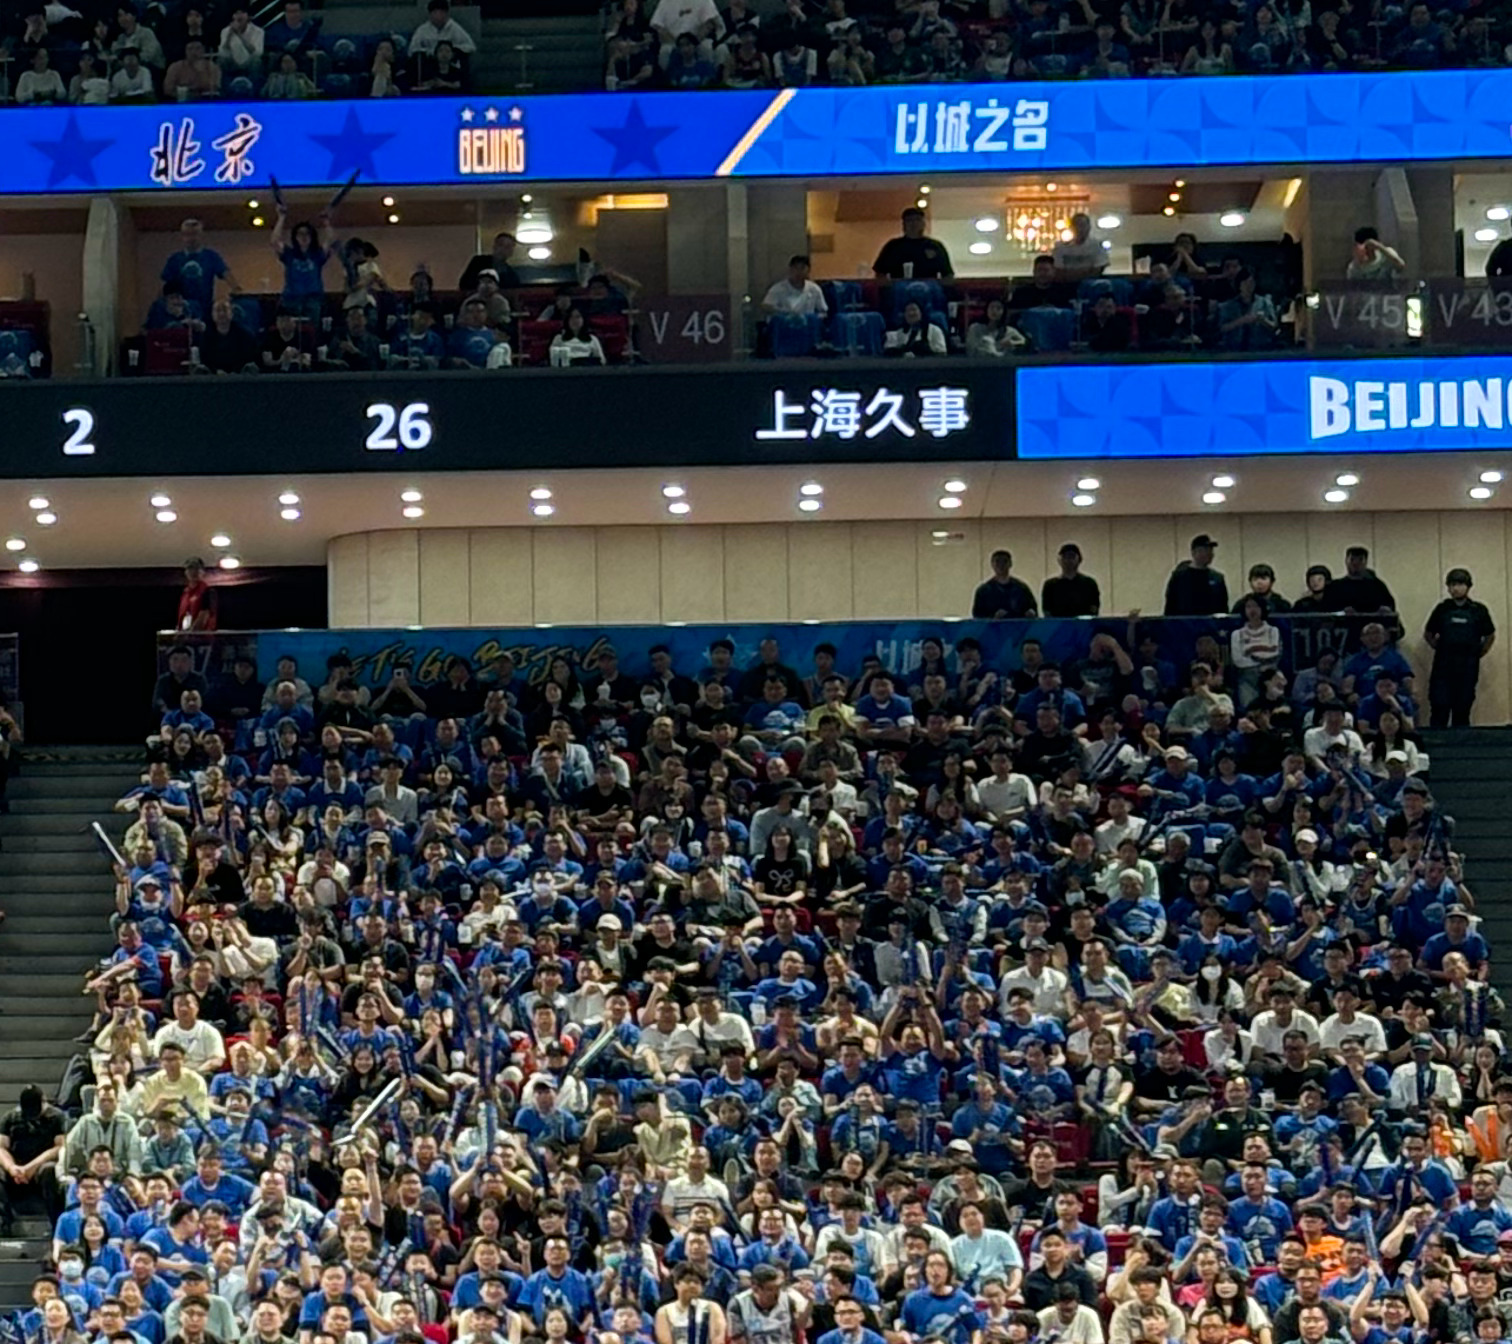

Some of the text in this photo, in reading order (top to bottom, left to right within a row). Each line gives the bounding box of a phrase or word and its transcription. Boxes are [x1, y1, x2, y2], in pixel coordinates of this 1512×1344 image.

[150, 113, 262, 186] 北京
[458, 127, 524, 174] BEIJING
[895, 99, 1049, 154] 以城之名
[649, 310, 725, 344] V 46
[1325, 294, 1402, 330] V 45
[63, 409, 95, 456] 2
[365, 403, 433, 450] 26
[755, 386, 971, 441] 上海久事
[1310, 375, 1512, 439] BEIJIN
